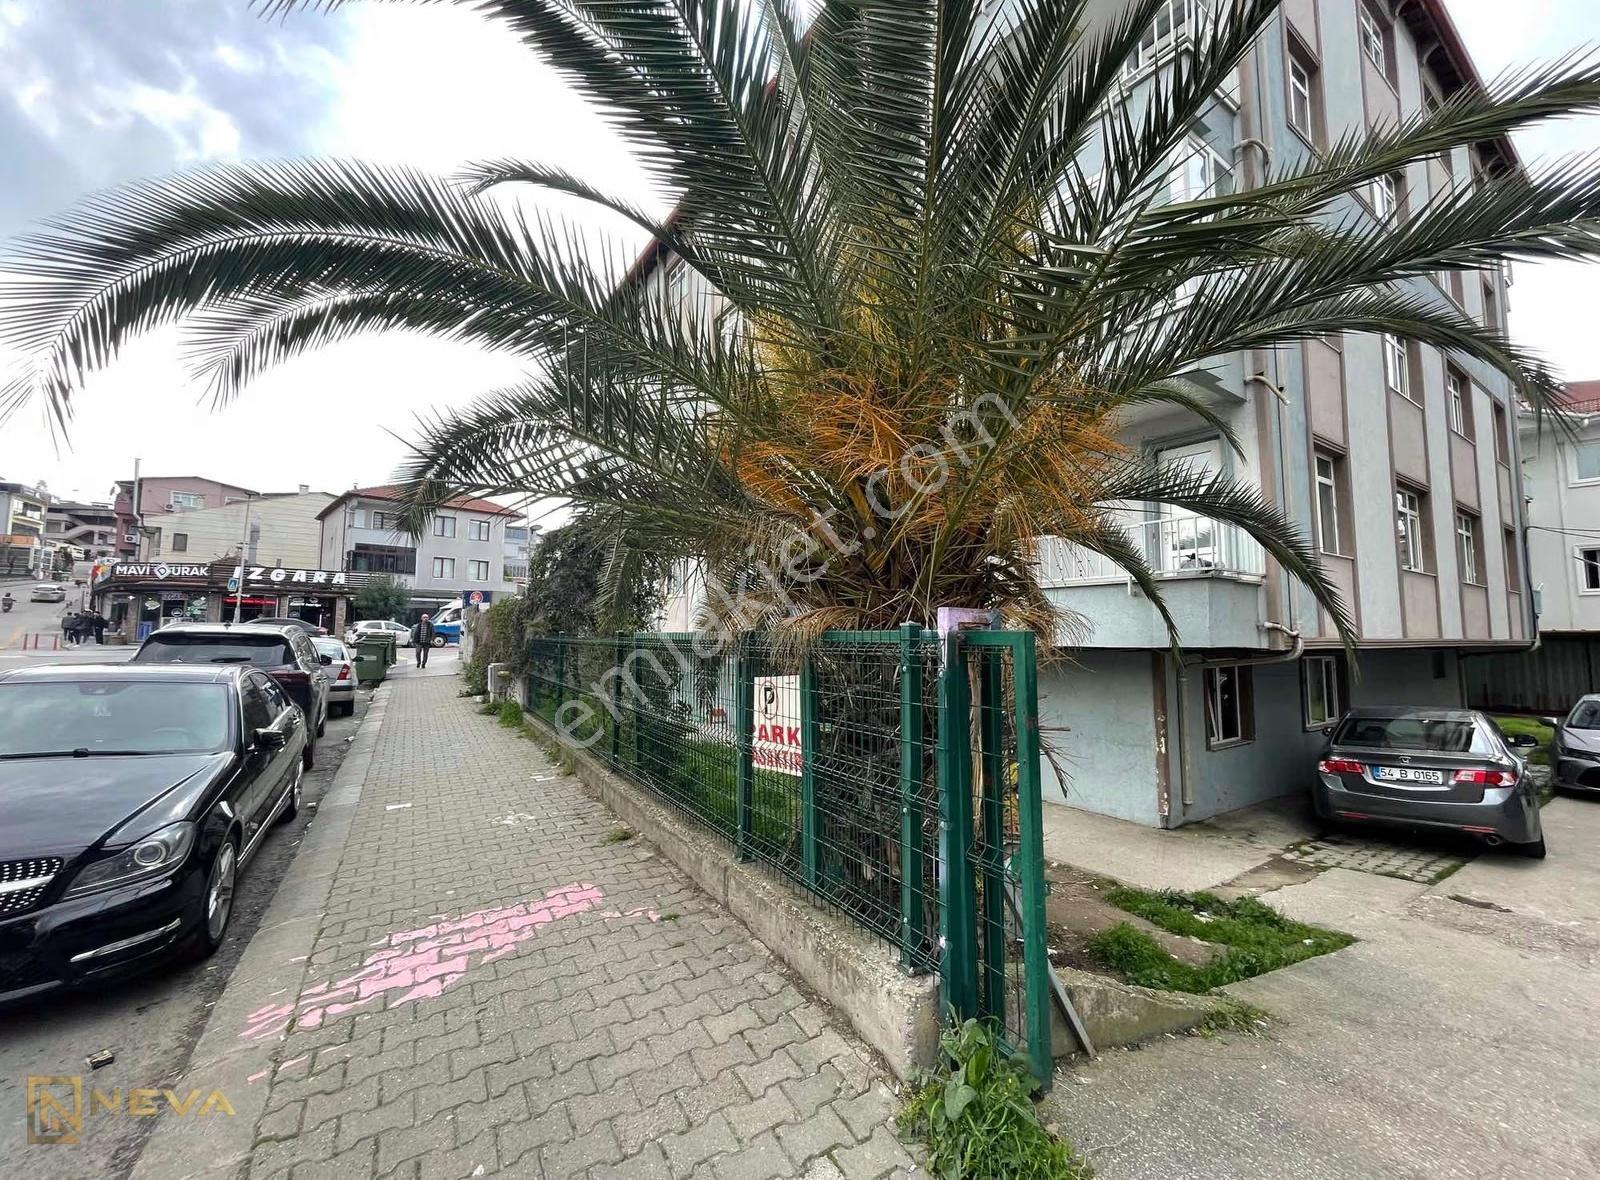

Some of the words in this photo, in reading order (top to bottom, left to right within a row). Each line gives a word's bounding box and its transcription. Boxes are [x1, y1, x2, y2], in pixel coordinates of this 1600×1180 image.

[115, 563, 150, 576] MAVİ
[155, 563, 209, 578] DURAK
[1380, 768, 1394, 777] 54
[1400, 769, 1408, 778] B
[1413, 770, 1440, 780] 0165
